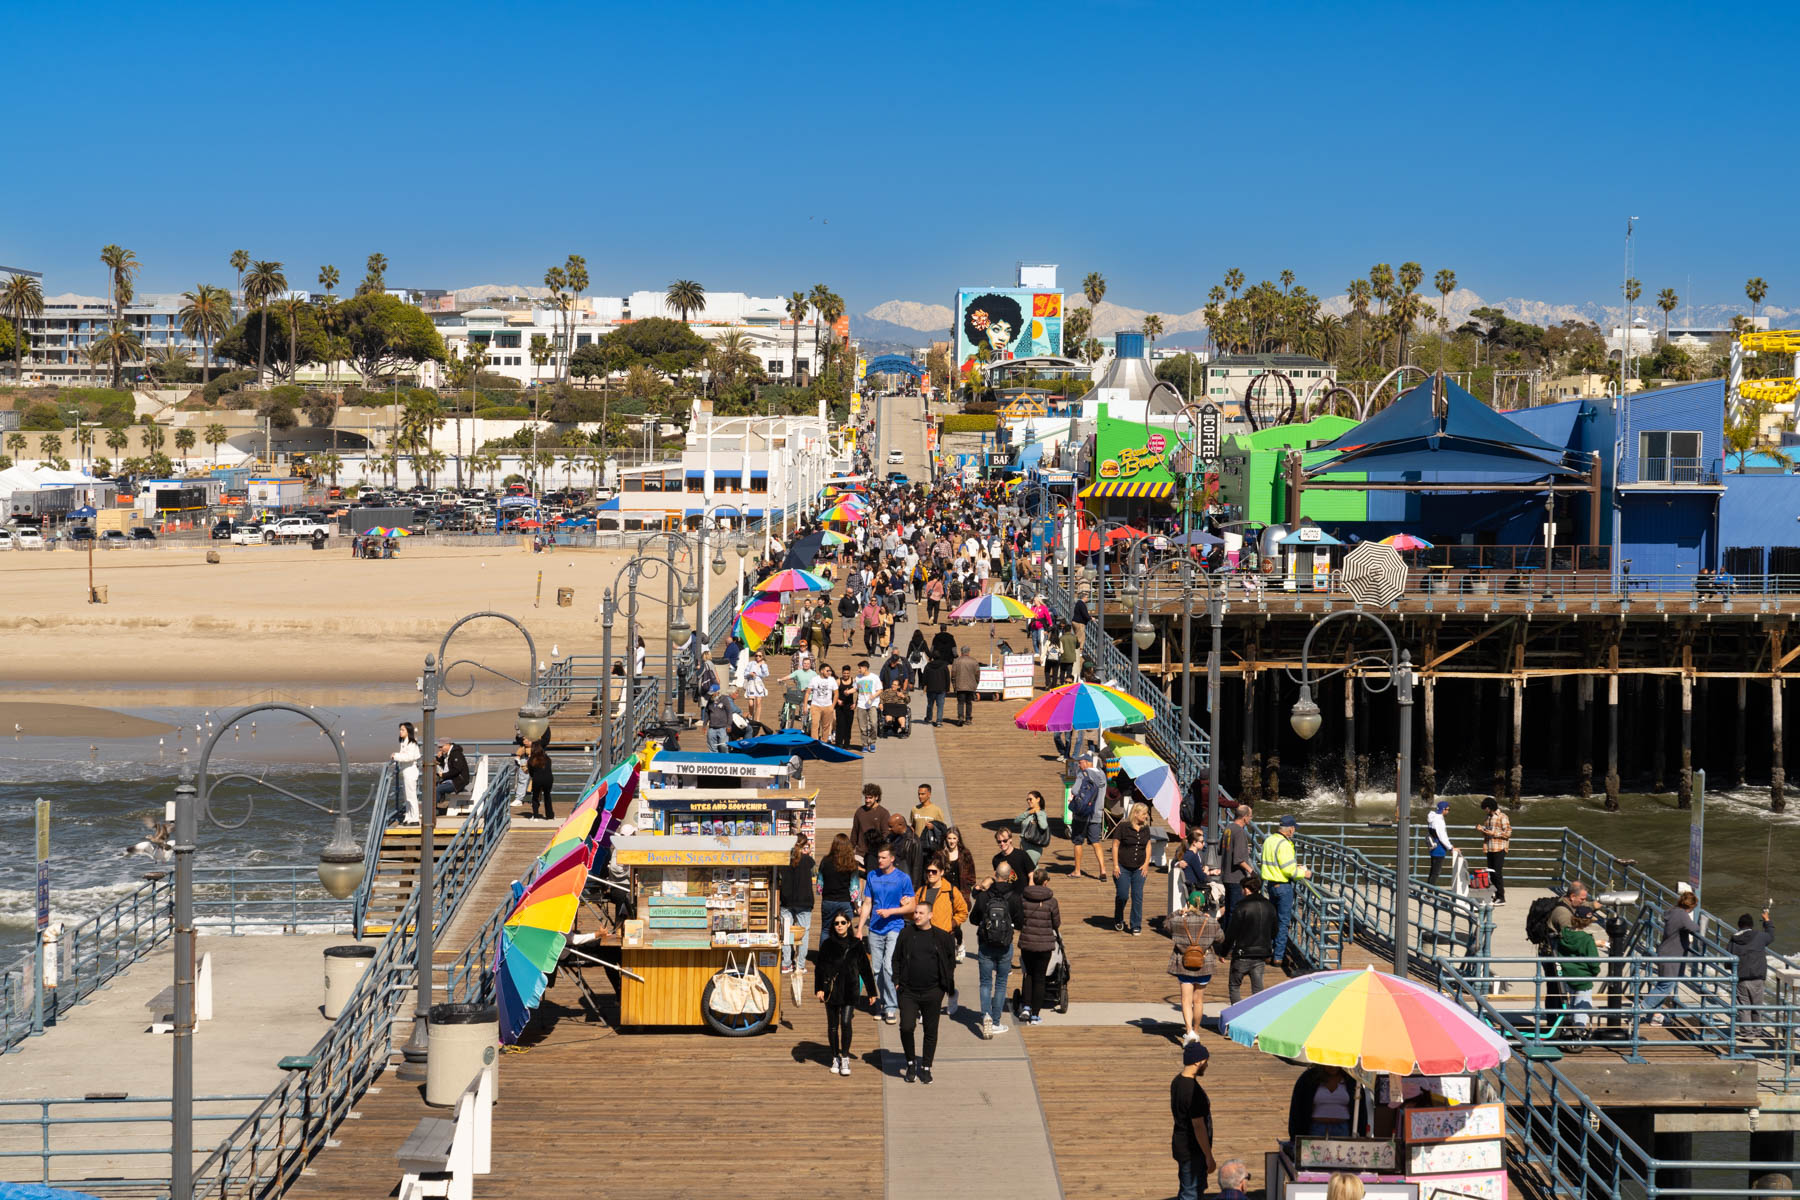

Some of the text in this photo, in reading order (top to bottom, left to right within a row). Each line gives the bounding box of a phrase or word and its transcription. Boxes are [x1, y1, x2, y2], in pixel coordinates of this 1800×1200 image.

[1203, 419, 1216, 458] COFFEE
[1121, 453, 1166, 476] Burger
[676, 764, 757, 776] TWO PHOTOS IN ONE
[647, 852, 760, 865] Beach Signs & Gifts
